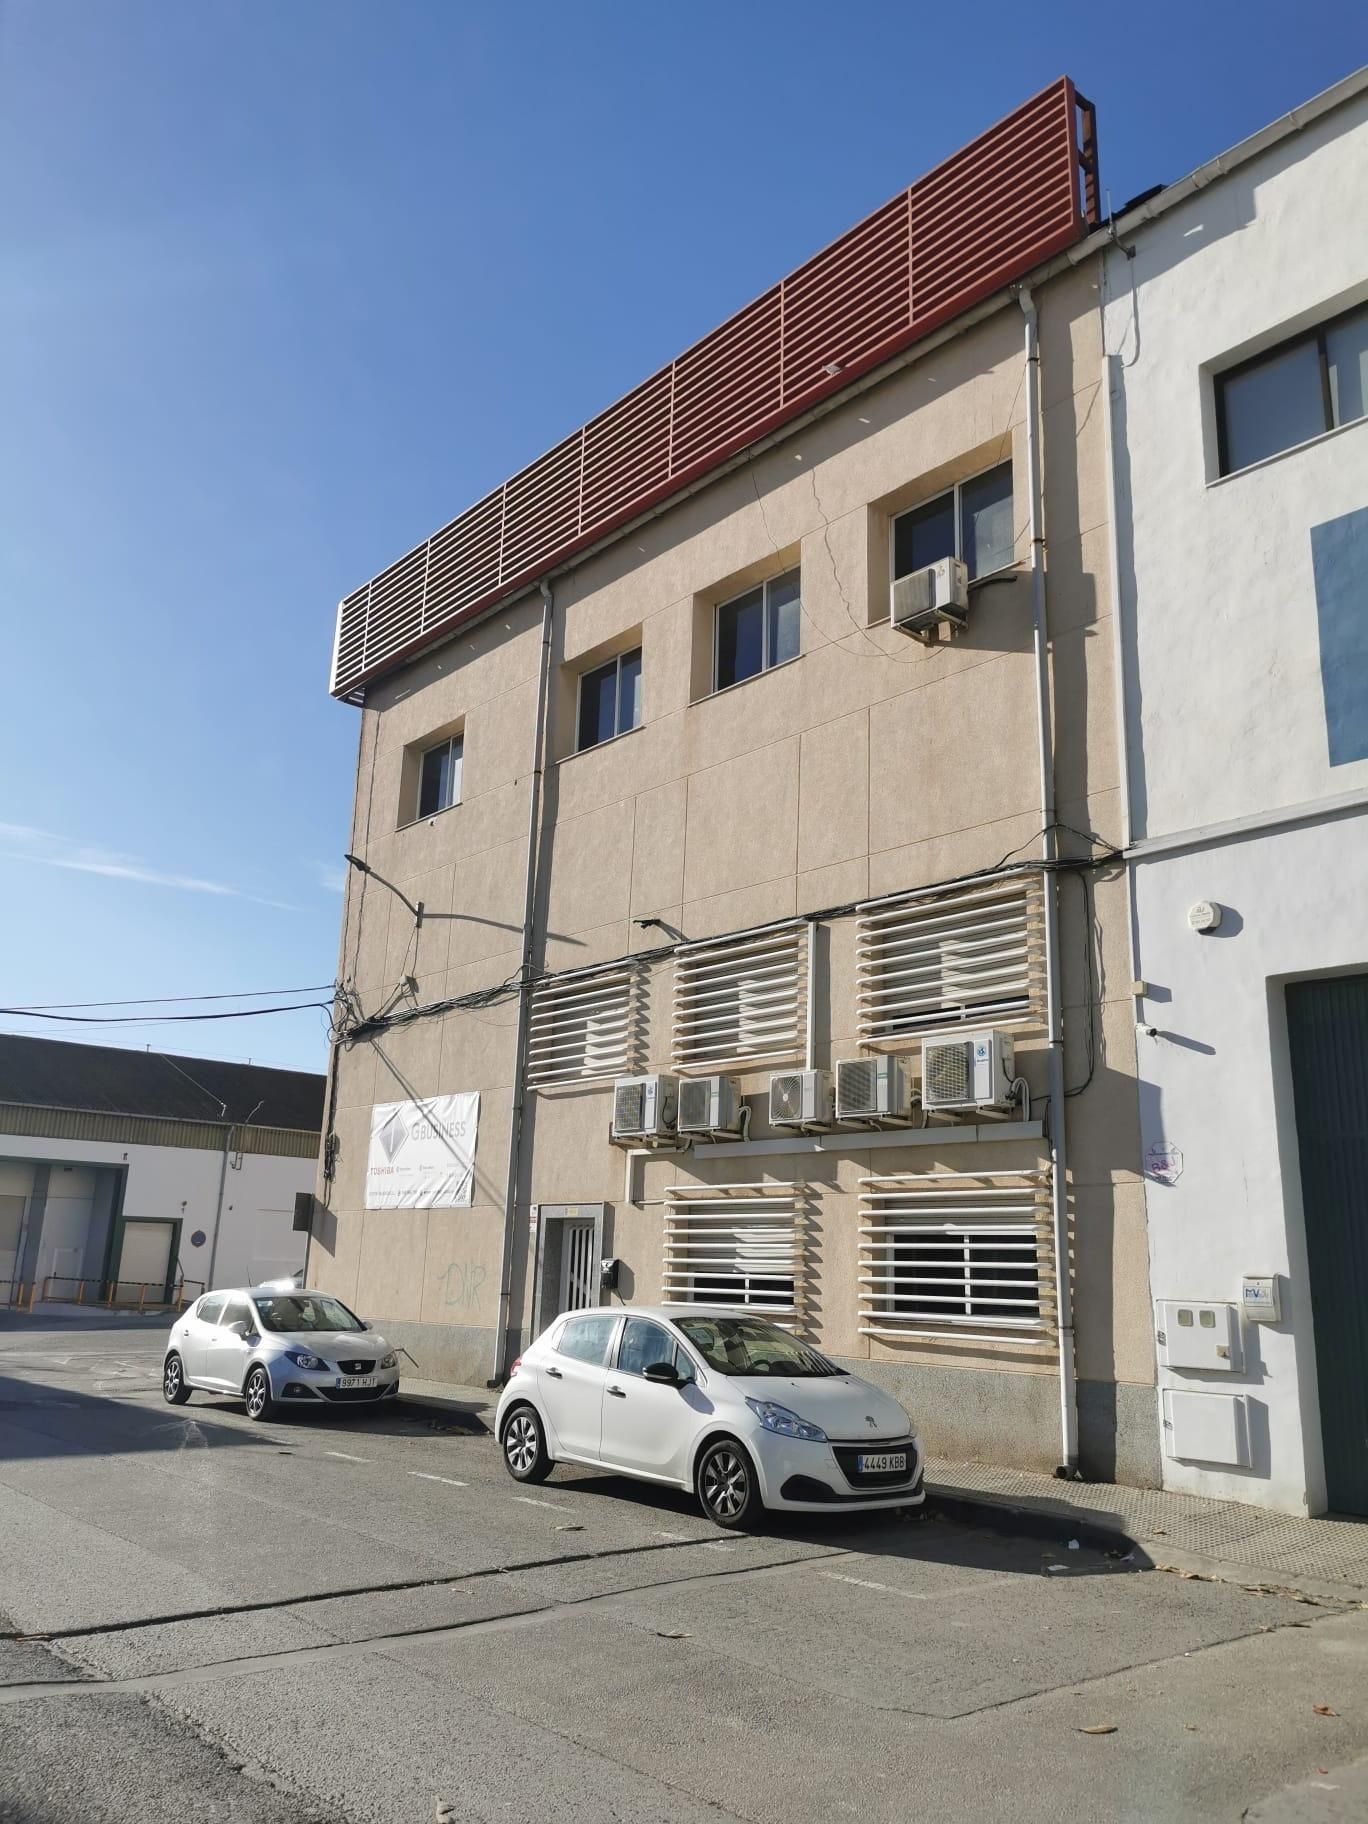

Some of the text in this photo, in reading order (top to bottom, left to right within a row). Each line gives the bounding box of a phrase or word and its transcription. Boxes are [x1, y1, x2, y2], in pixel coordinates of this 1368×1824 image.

[370, 1166, 394, 1175] TOSHIBA
[864, 1455, 905, 1469] 4449 KBB
